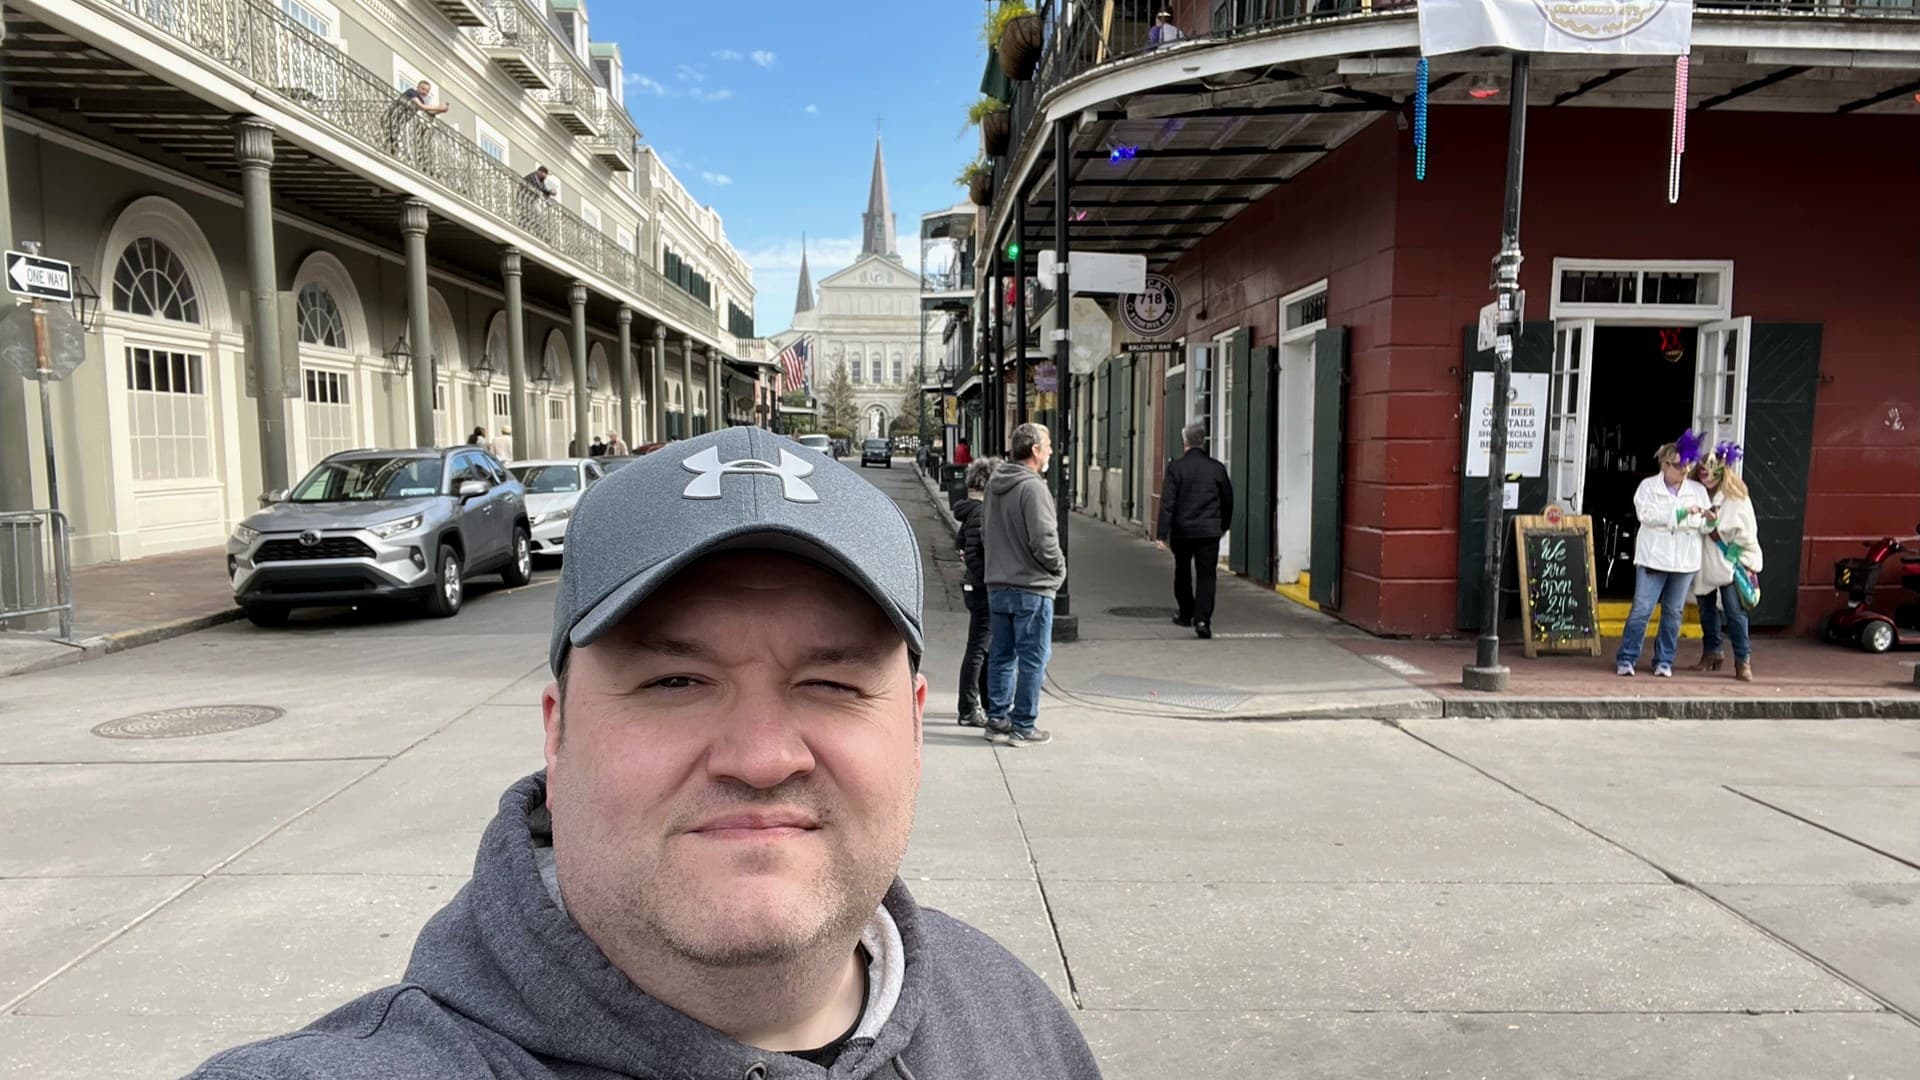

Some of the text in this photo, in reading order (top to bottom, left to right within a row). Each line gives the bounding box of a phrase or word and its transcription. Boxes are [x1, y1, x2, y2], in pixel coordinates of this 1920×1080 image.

[27, 268, 64, 288] ONE WAY
[1140, 293, 1162, 304] 718
[1511, 407, 1535, 417] BEER
[1541, 537, 1566, 561] We
